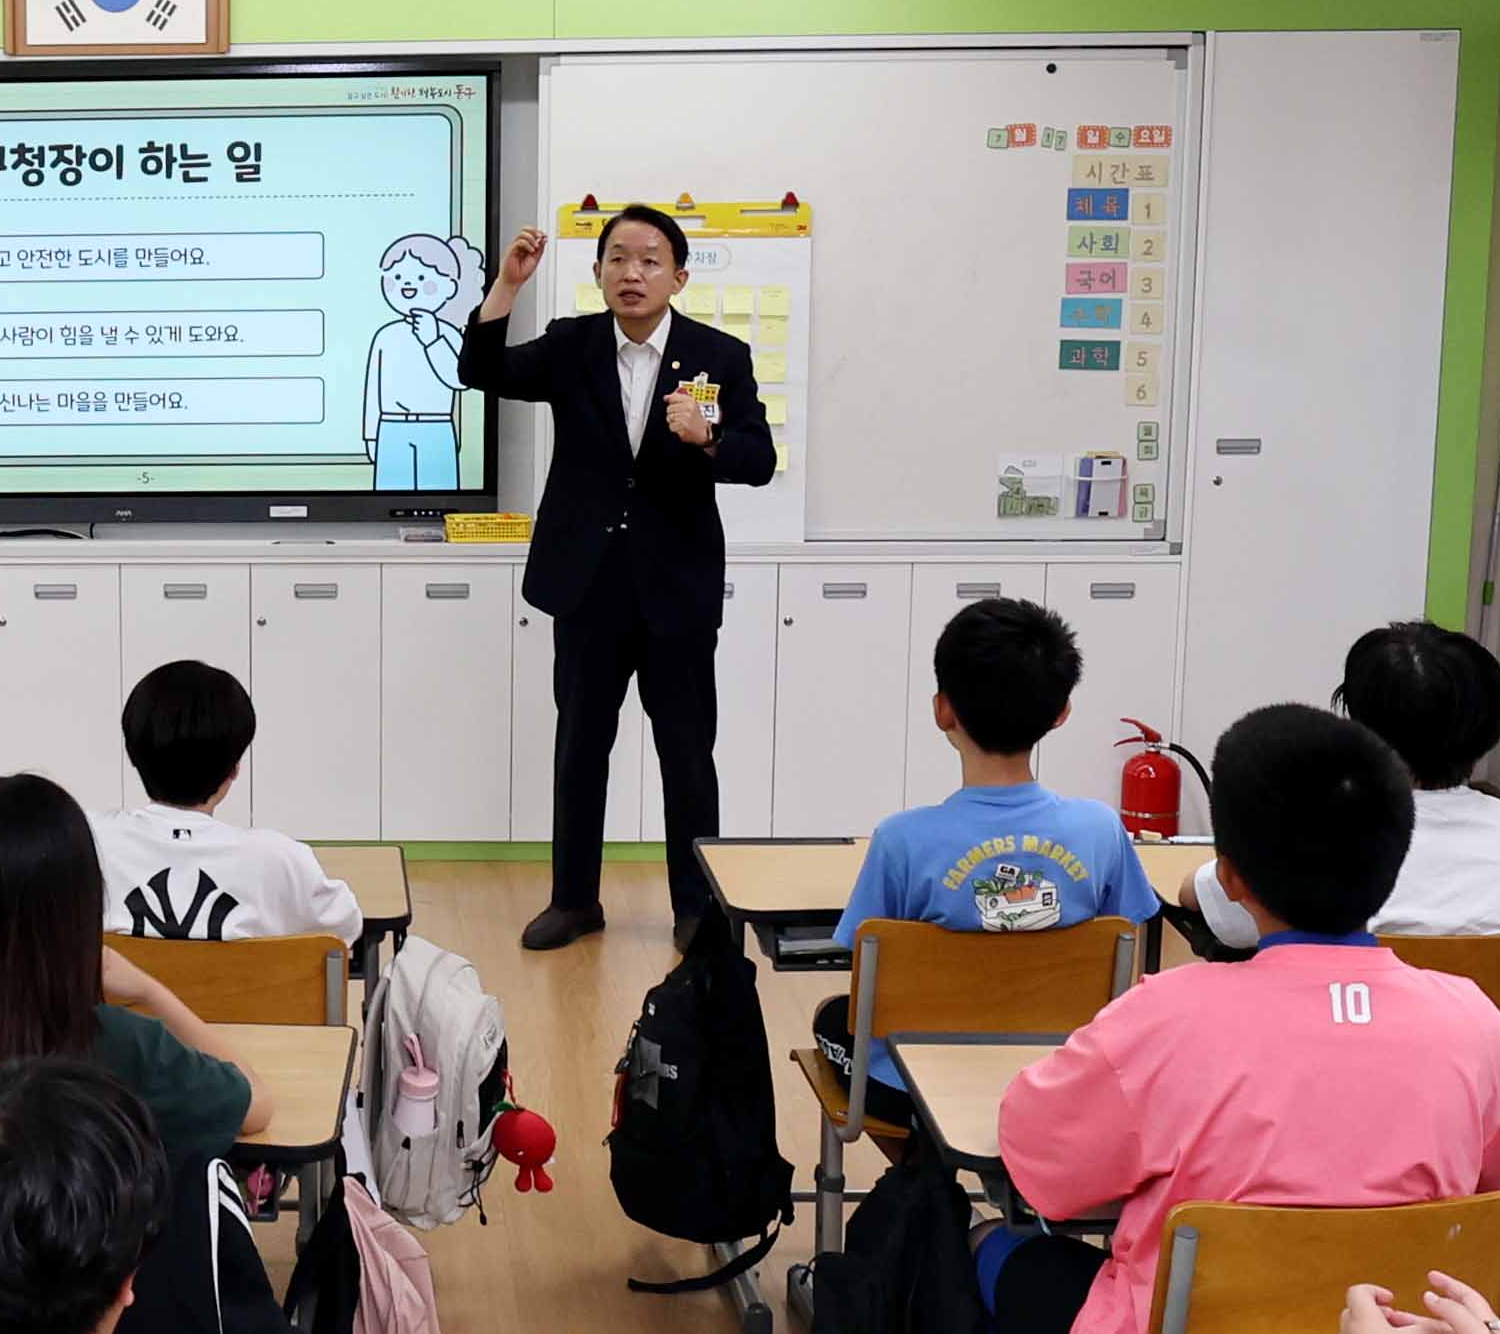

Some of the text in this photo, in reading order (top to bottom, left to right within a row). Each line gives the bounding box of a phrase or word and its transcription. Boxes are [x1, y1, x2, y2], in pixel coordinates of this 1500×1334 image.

[1087, 129, 1100, 143] 일
[1115, 131, 1126, 144] 수
[1139, 129, 1165, 143] 요일
[138, 140, 212, 183] 하는
[226, 141, 262, 183] 일
[1085, 162, 1156, 185] 시간표
[1078, 232, 1153, 256] 사회 2
[17, 248, 72, 268] 안전한
[78, 247, 129, 268] 도시를
[135, 247, 211, 267] 만들어요.
[1076, 267, 1153, 293] 국어 3
[1140, 312, 1152, 328] 4
[0, 326, 53, 346] 사람이
[59, 325, 94, 346] 힘을
[100, 325, 119, 345] 낼
[123, 326, 140, 345] 수
[145, 325, 182, 344] 있게
[188, 324, 245, 344] 도와요.
[1070, 347, 1148, 367] 과학 5
[0, 393, 51, 413] 신나는
[56, 392, 107, 412] 마을을
[114, 392, 189, 411] 만들어요.
[1137, 385, 1146, 400] 6
[942, 835, 1089, 891] FARMERS MARKET
[1329, 982, 1372, 1024] 10
